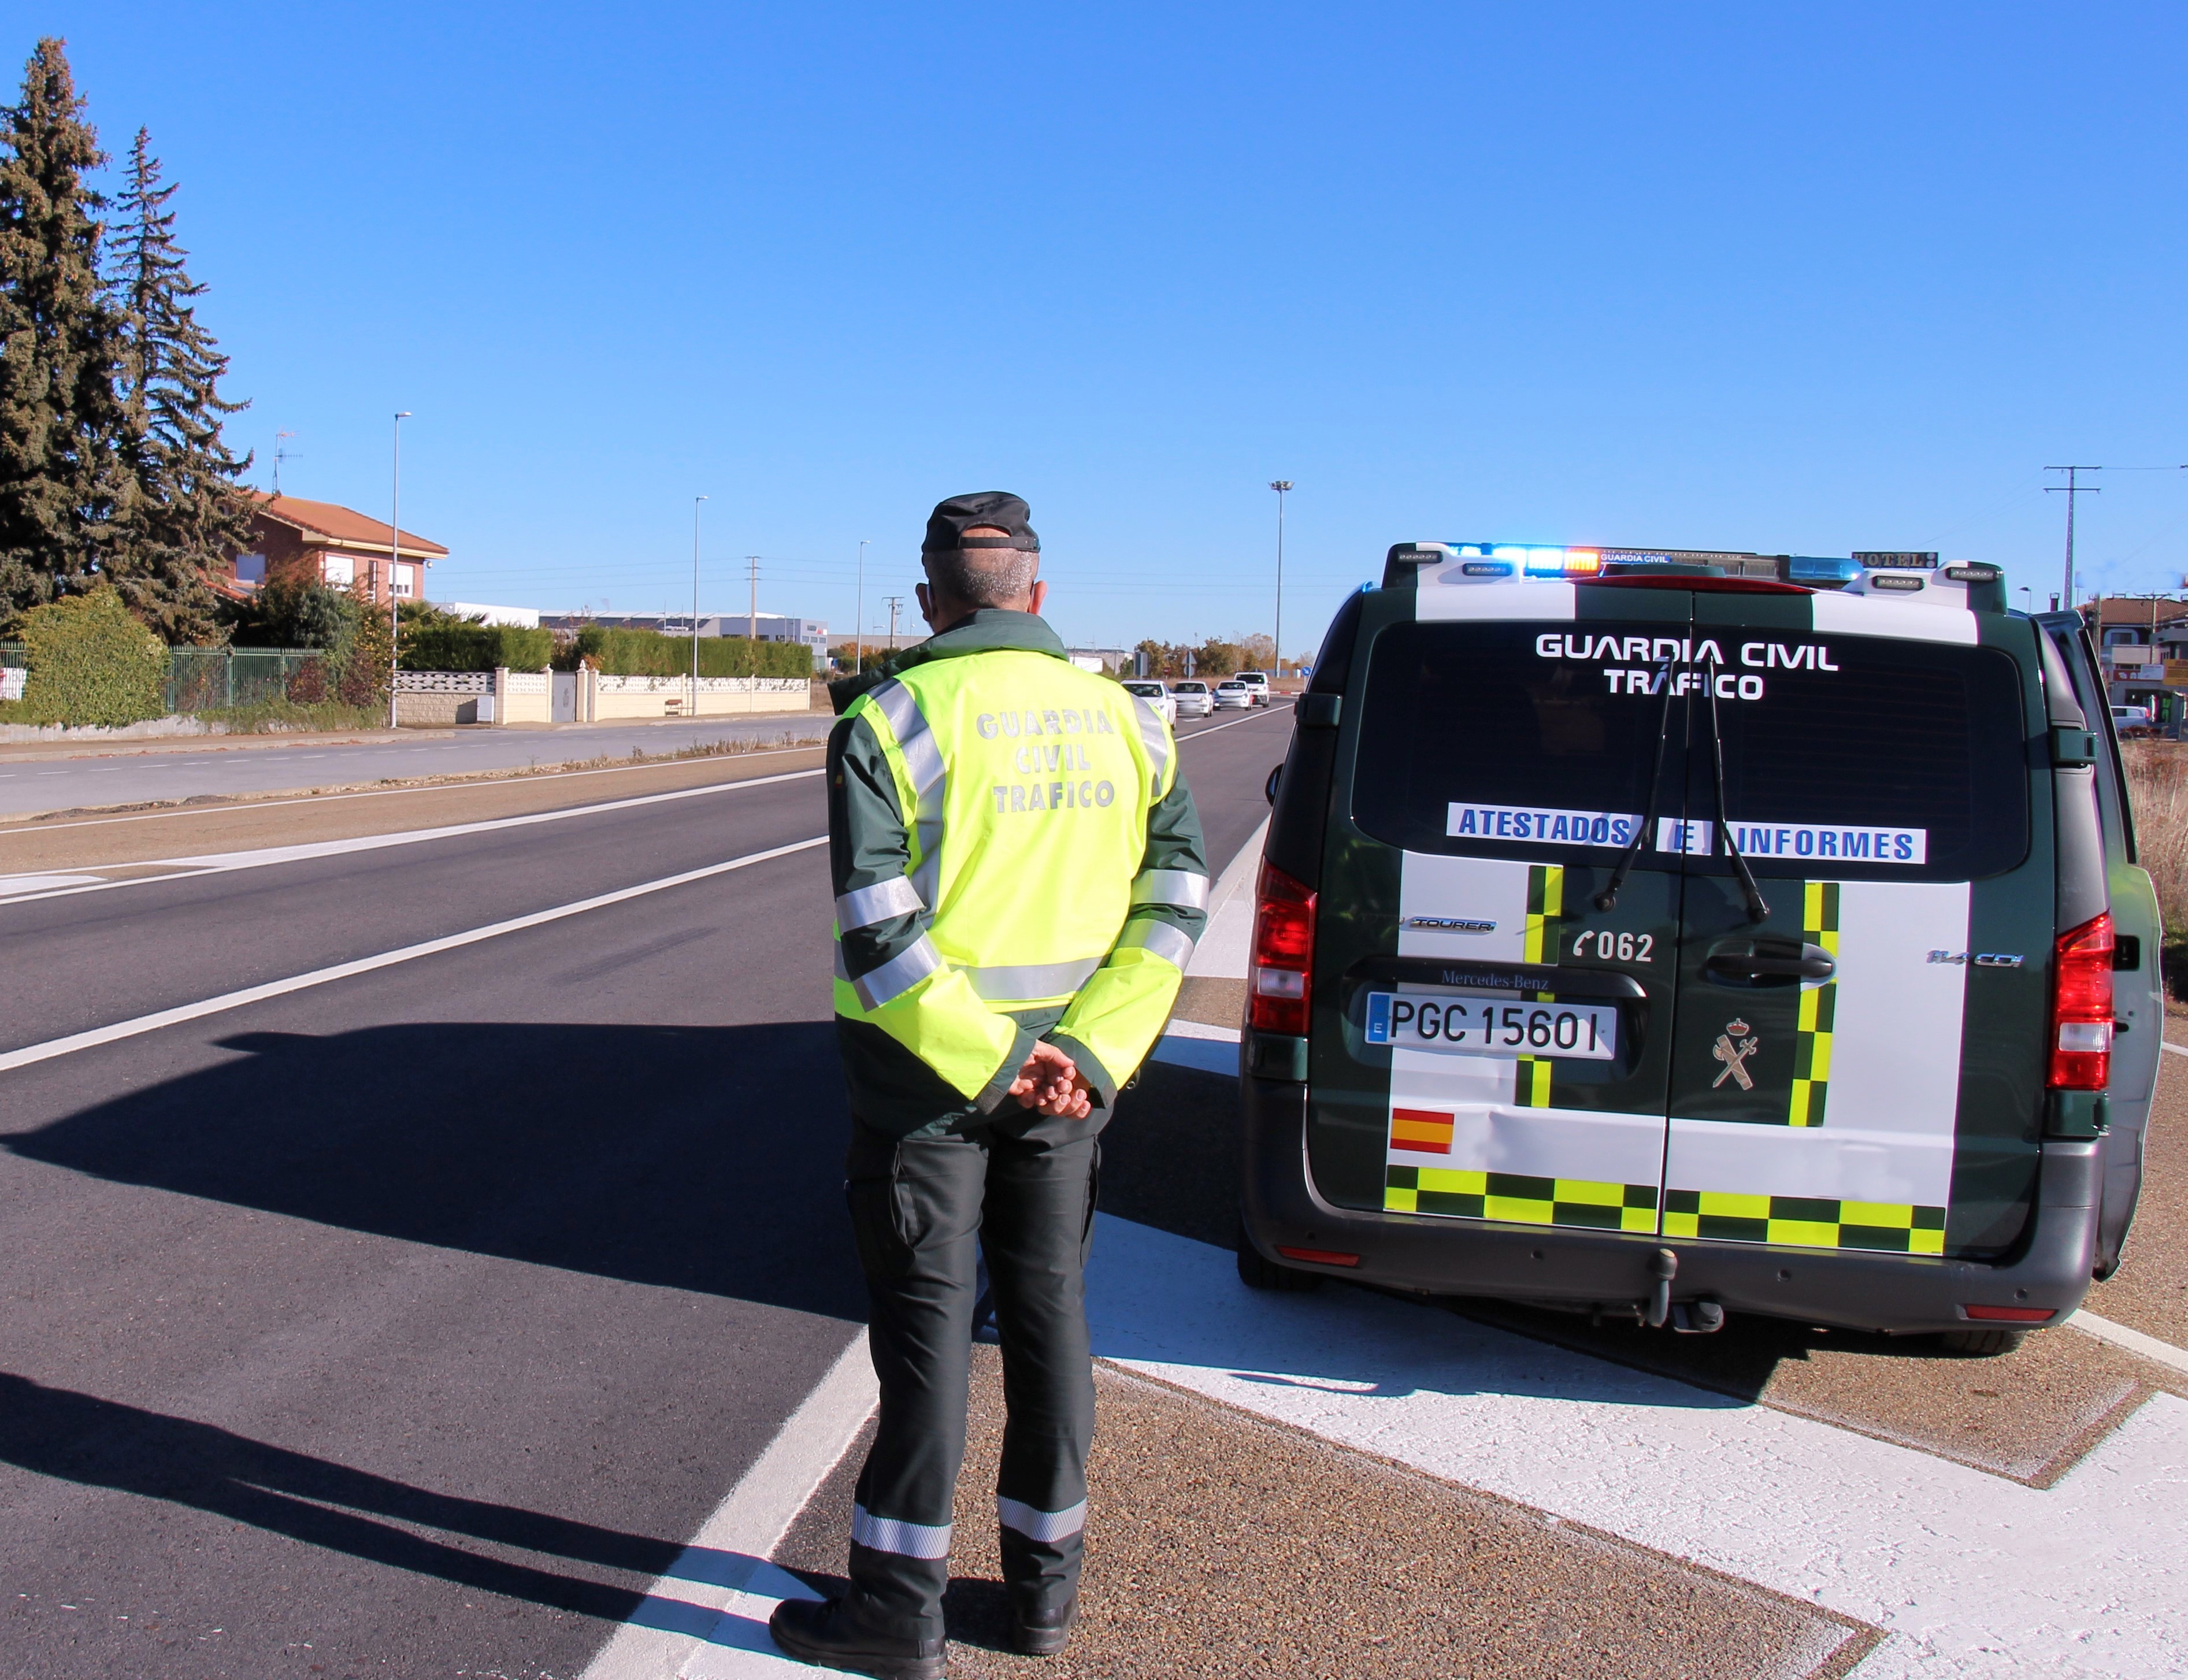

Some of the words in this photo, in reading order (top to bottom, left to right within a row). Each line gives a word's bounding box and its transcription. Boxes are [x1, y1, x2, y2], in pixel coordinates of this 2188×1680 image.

[1601, 554, 1642, 562] GUARDIA
[1644, 555, 1668, 563] CIVIL
[1853, 553, 1923, 566] HOTEL
[1536, 633, 1725, 665] GUARDIA
[1741, 641, 1840, 672] CIVIL
[976, 709, 1114, 740] GUARDIA
[1015, 743, 1091, 774] CIVIL
[993, 780, 1115, 813] TRAFICO
[1458, 809, 1630, 845] ATESTADOS
[1673, 824, 1695, 851] E
[1737, 826, 1913, 860] INFORMES
[1415, 918, 1493, 932] TOURER
[1597, 931, 1653, 962] 062
[1441, 970, 1549, 990] Mercedes-Benz
[1373, 1022, 1383, 1034] E
[1390, 1000, 1468, 1042] PGC
